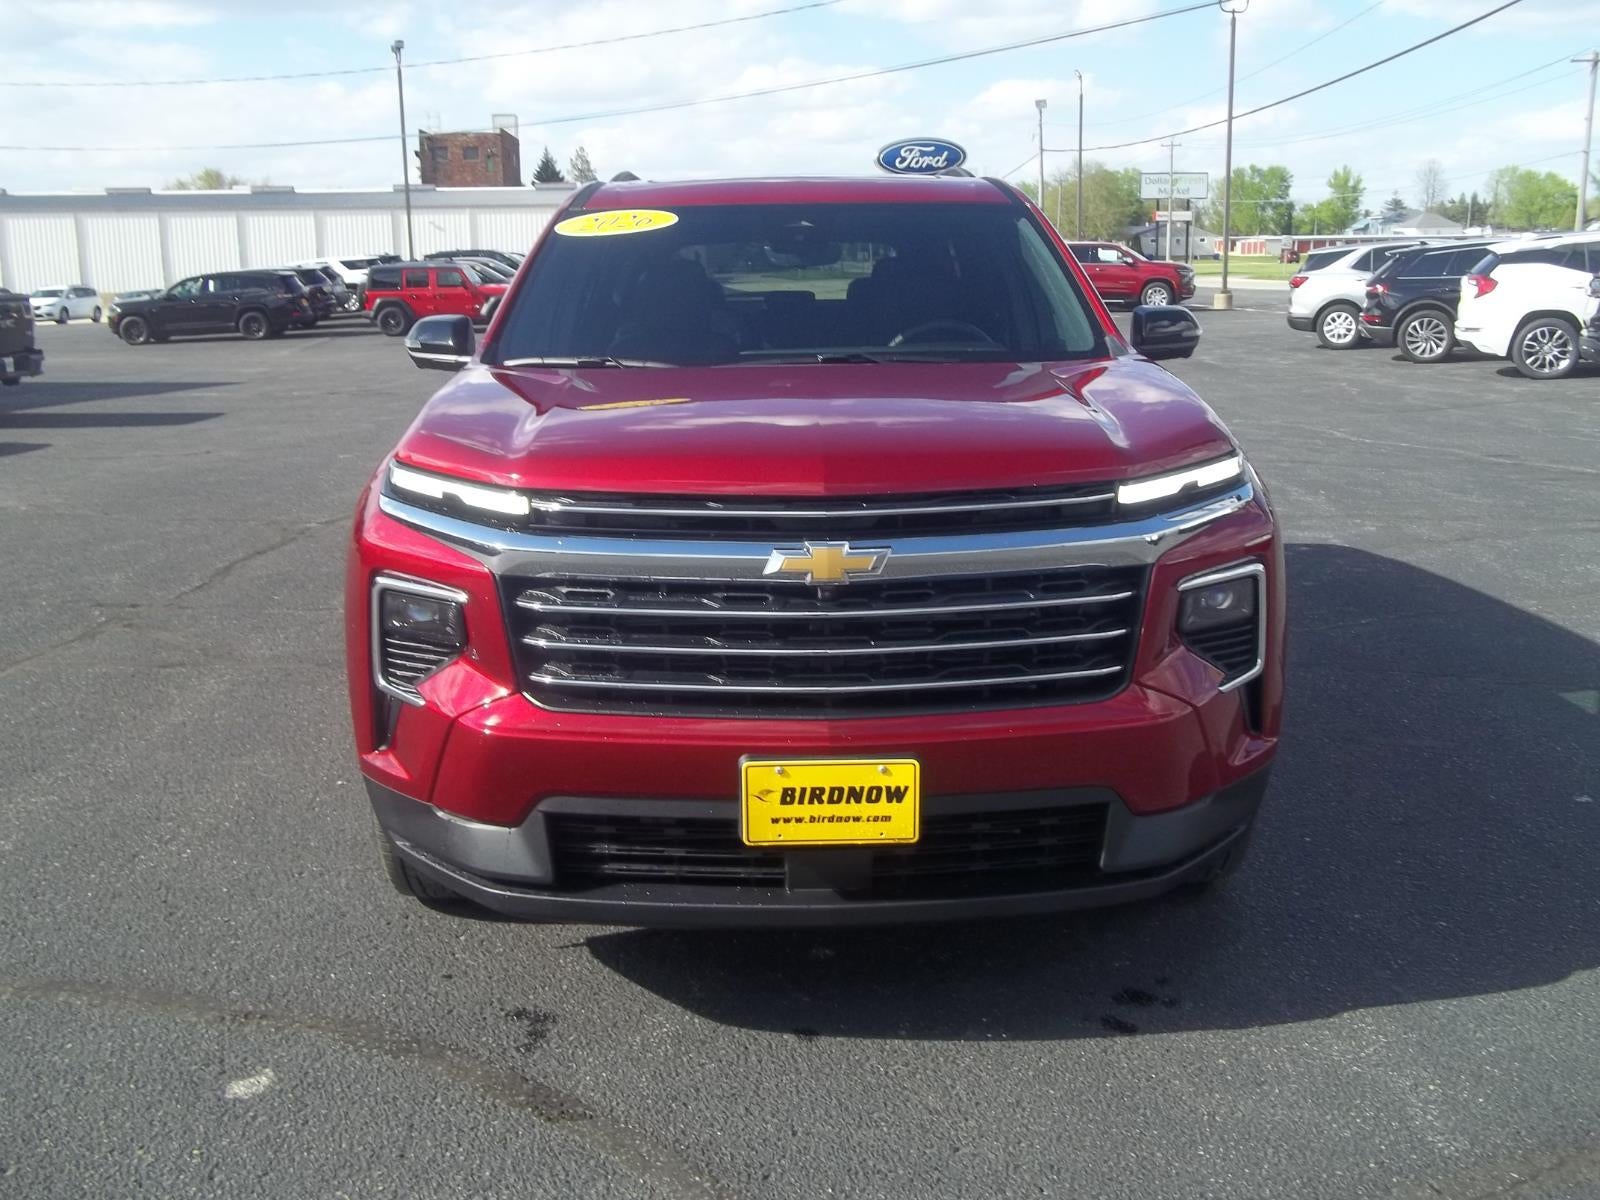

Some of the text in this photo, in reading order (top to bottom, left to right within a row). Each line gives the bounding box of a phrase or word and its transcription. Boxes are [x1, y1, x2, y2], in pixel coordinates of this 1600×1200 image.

[895, 145, 949, 169] Ford
[779, 785, 910, 806] BIRDNOW
[770, 814, 892, 825] www.birdnow.com
